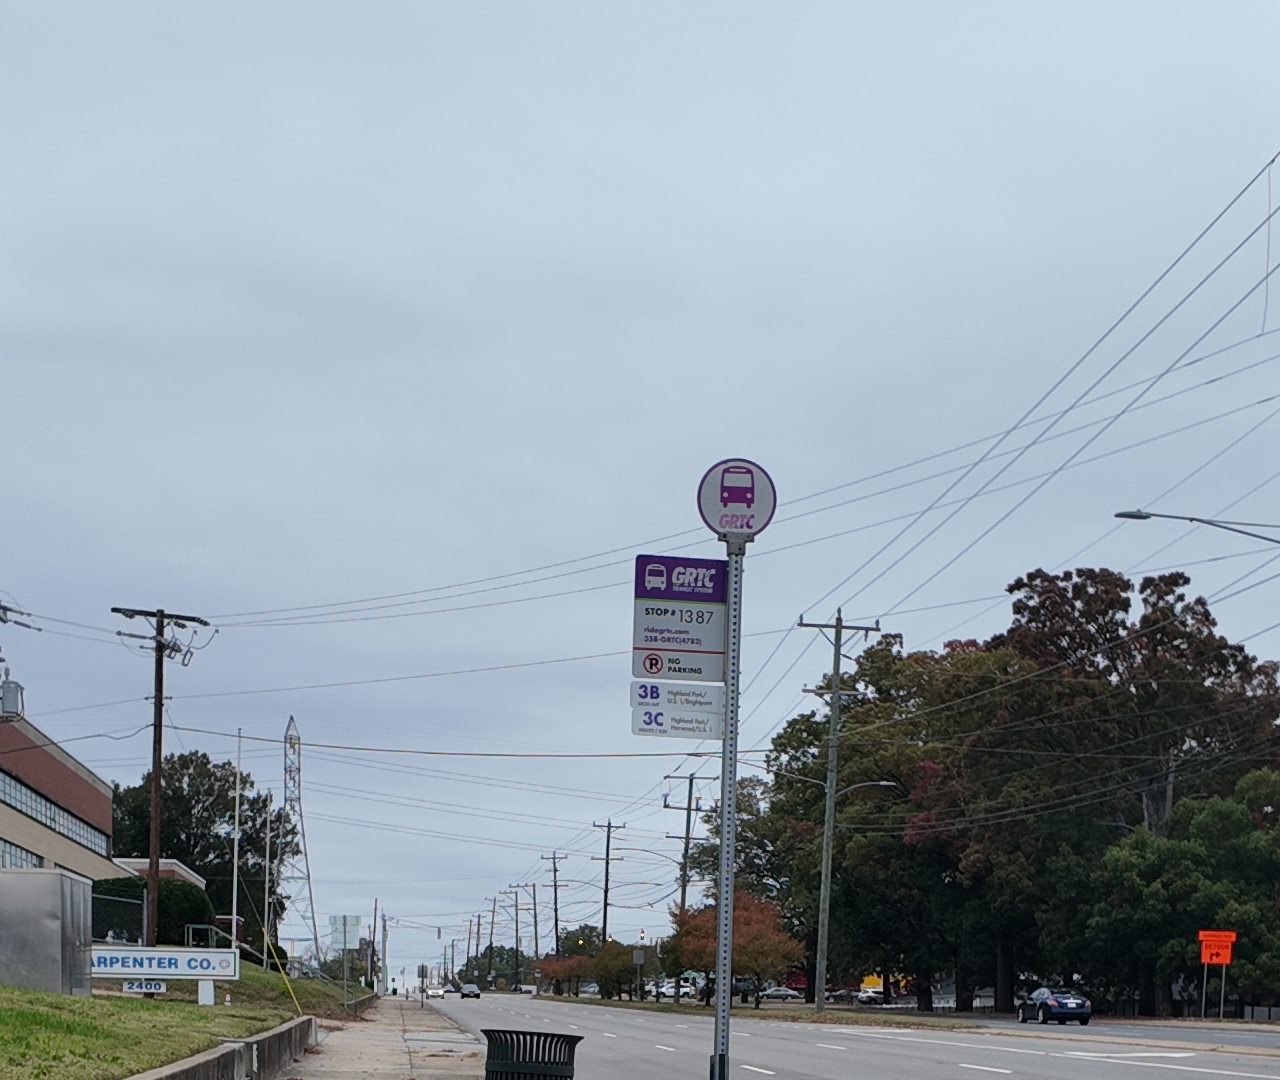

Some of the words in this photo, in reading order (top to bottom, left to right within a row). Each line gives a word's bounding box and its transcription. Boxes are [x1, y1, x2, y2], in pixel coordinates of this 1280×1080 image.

[719, 514, 755, 529] GRTC
[672, 567, 716, 587] GRTC
[644, 608, 669, 616] STOP
[678, 610, 714, 625] 1387
[644, 626, 689, 635] ridegrtc.com
[668, 666, 703, 674] PARKING
[638, 684, 660, 700] 3B
[667, 690, 691, 698] Highland
[642, 711, 664, 727] 3C
[671, 717, 693, 725] Highland
[187, 957, 216, 970] CO.
[126, 981, 162, 991] 2400
